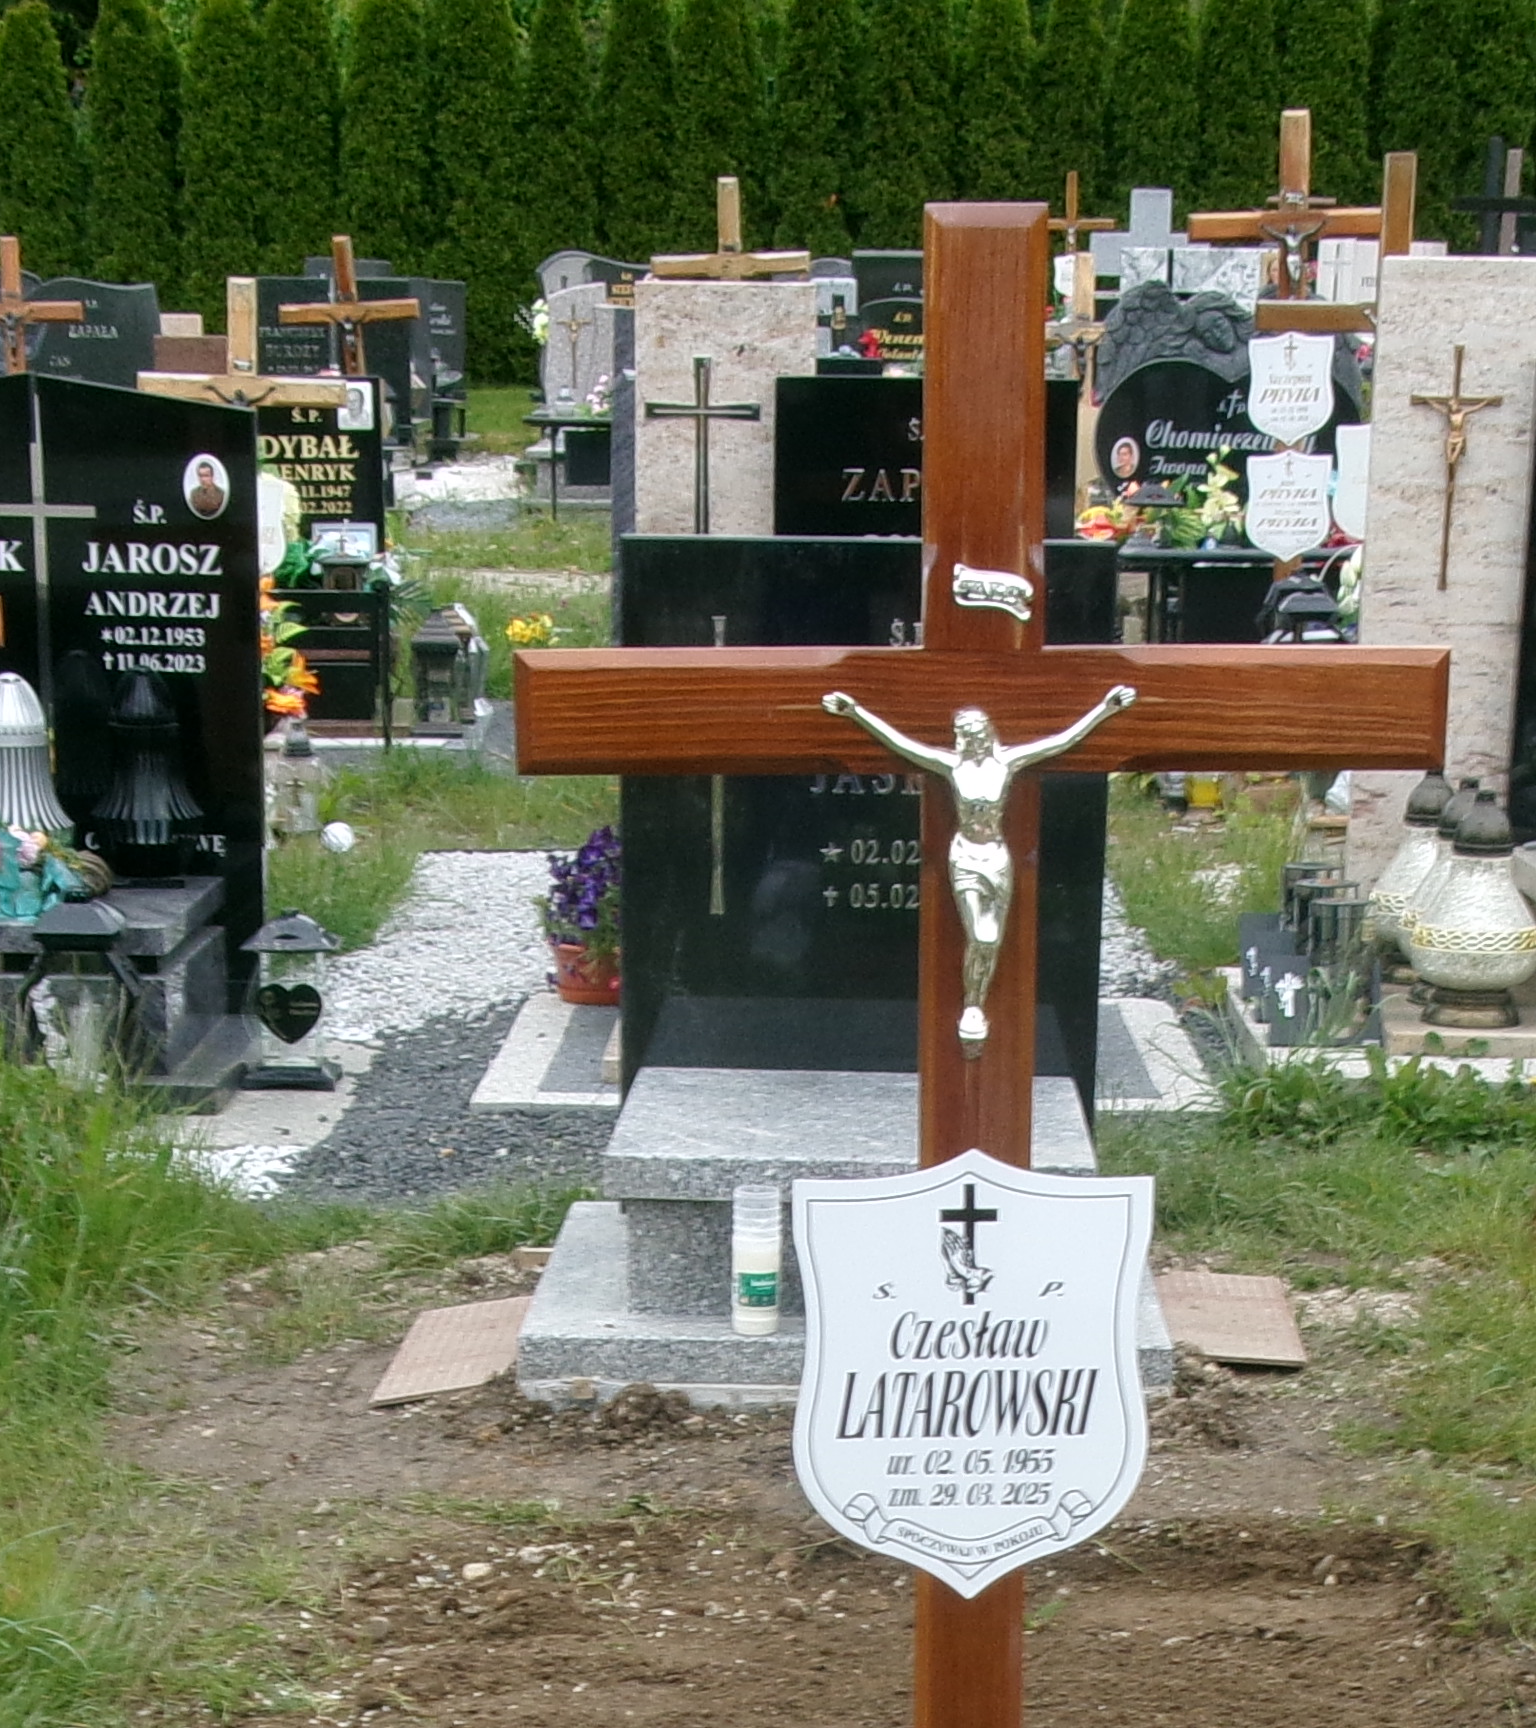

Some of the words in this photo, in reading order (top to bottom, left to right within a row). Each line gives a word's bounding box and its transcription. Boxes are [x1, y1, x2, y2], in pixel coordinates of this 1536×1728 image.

[257, 435, 360, 459] DYBAŁ
[279, 464, 357, 481] ENRYK
[841, 468, 923, 502] ZAP
[132, 499, 167, 525] Ś.P.
[81, 541, 223, 576] JAROSZ
[84, 590, 221, 619] ANDRZEJ
[114, 626, 205, 648] 02.12.1953
[115, 651, 206, 673] 11.06.2023
[849, 838, 921, 865] 02.02
[849, 883, 921, 909] 05.02
[1039, 1280, 1065, 1298] P.
[890, 1310, 1048, 1361] Czesław
[835, 1367, 1100, 1440] LATAROWSKI
[923, 1449, 955, 1476] 02.
[963, 1449, 995, 1475] 05.
[1002, 1448, 1056, 1475] 1955
[929, 1483, 957, 1507] 29.
[966, 1482, 995, 1507] 03.
[1000, 1482, 1051, 1506] 2025
